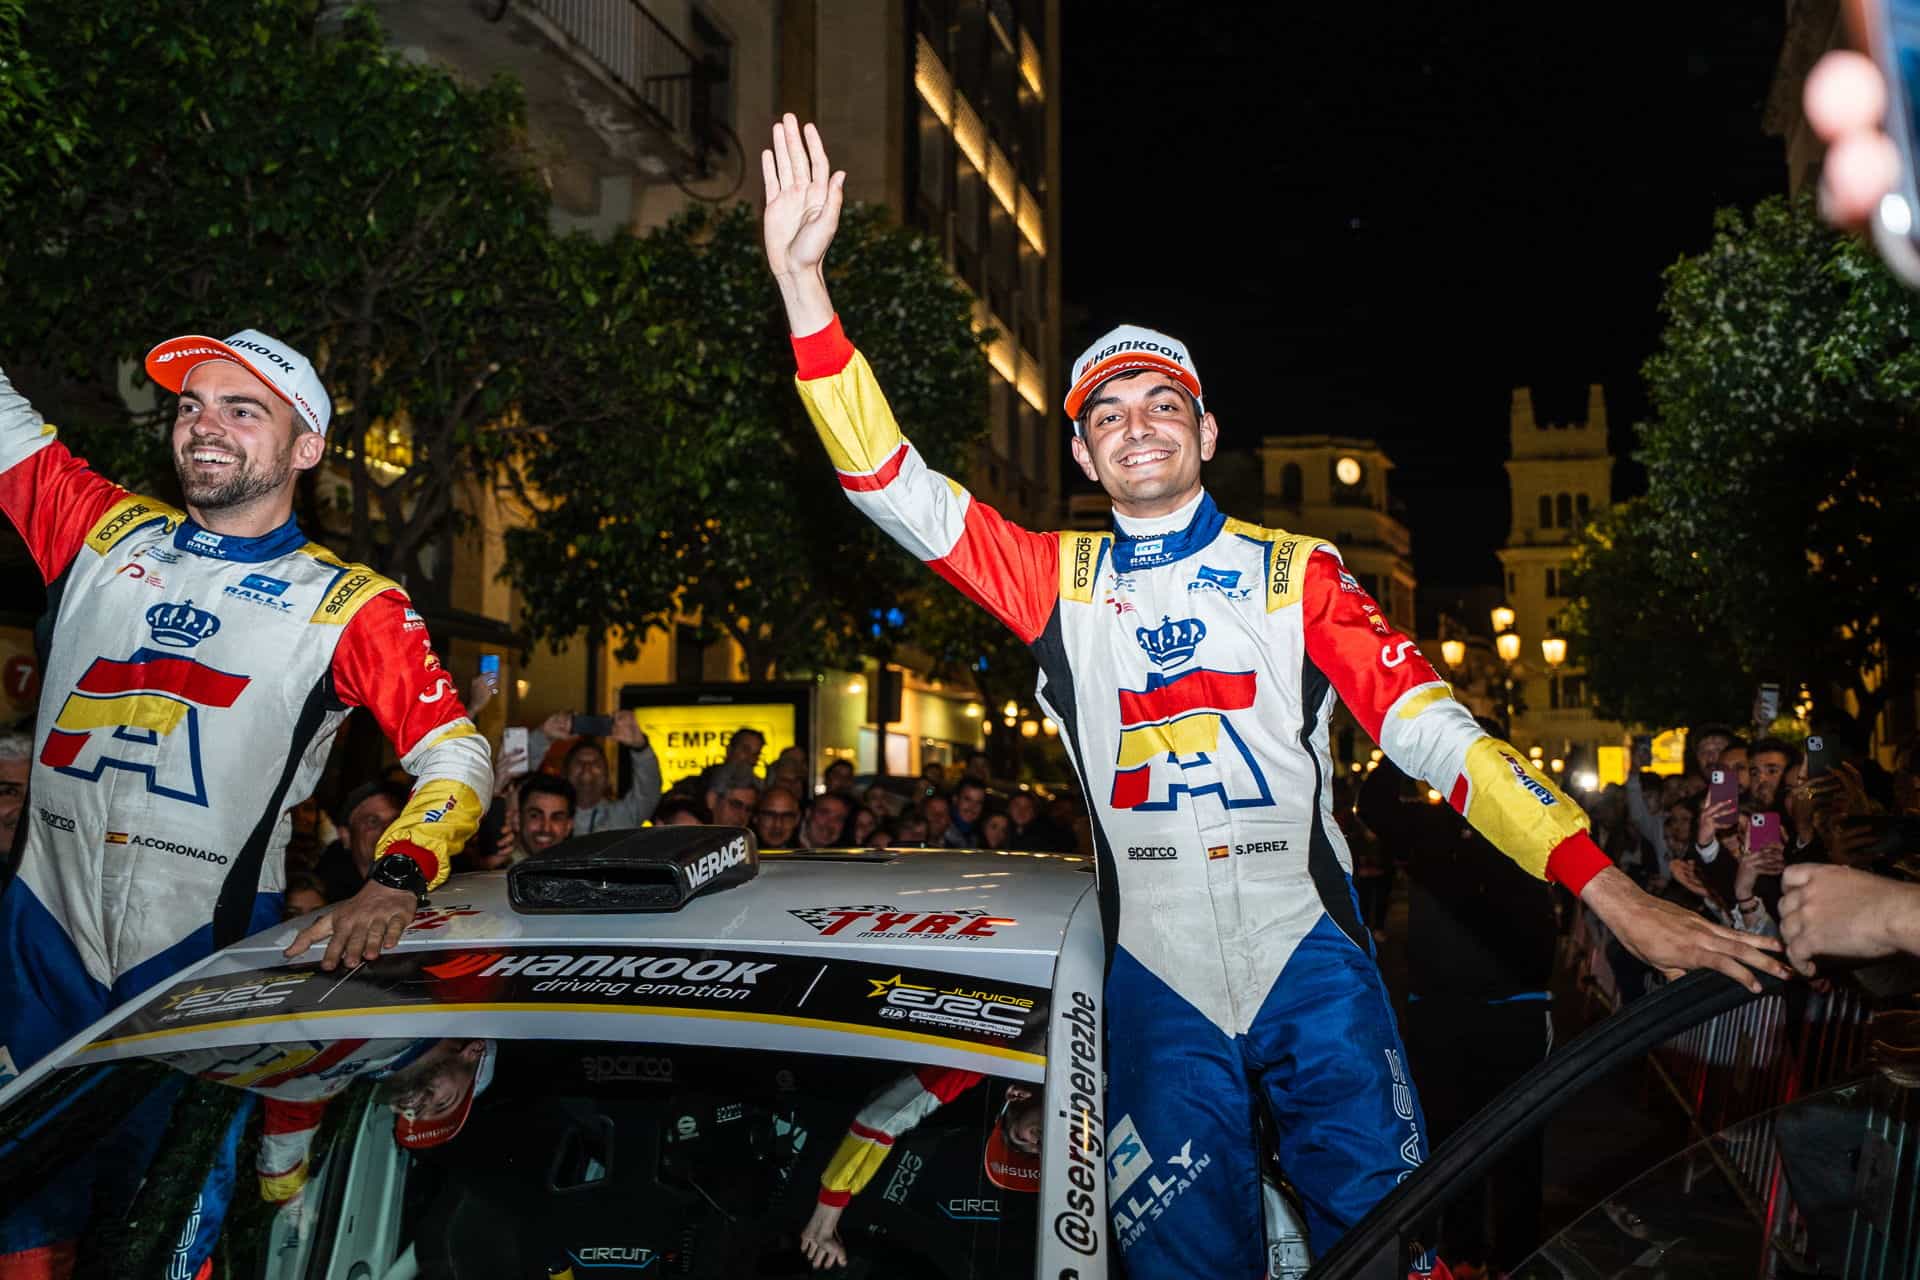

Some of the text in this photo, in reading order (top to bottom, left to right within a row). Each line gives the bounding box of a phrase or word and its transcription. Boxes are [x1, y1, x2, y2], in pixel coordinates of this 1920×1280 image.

[95, 503, 150, 541] sparco
[186, 540, 228, 555] RALLY
[1130, 551, 1174, 564] RALLY
[1073, 536, 1093, 590] sparco
[1273, 541, 1298, 595] sparco
[223, 585, 297, 609] RALLY
[325, 574, 371, 615] sparco
[39, 807, 76, 833] sparco
[131, 835, 229, 866] A.CORONADO
[1128, 846, 1178, 862] sparco
[1235, 840, 1288, 855] S.PEREZ
[819, 910, 1016, 937] TYRE
[856, 930, 985, 942] motorsport
[532, 978, 752, 1000] driving emotion
[939, 987, 1035, 1009] JUNIOR
[879, 1008, 905, 1019] FIA
[886, 987, 1031, 1025] ERC
[1055, 991, 1103, 1256] @sergiperezbe
[1113, 1138, 1193, 1241] ALLY
[1121, 1153, 1211, 1252] AM SPAIN
[579, 1247, 652, 1262] CIRCUIT
